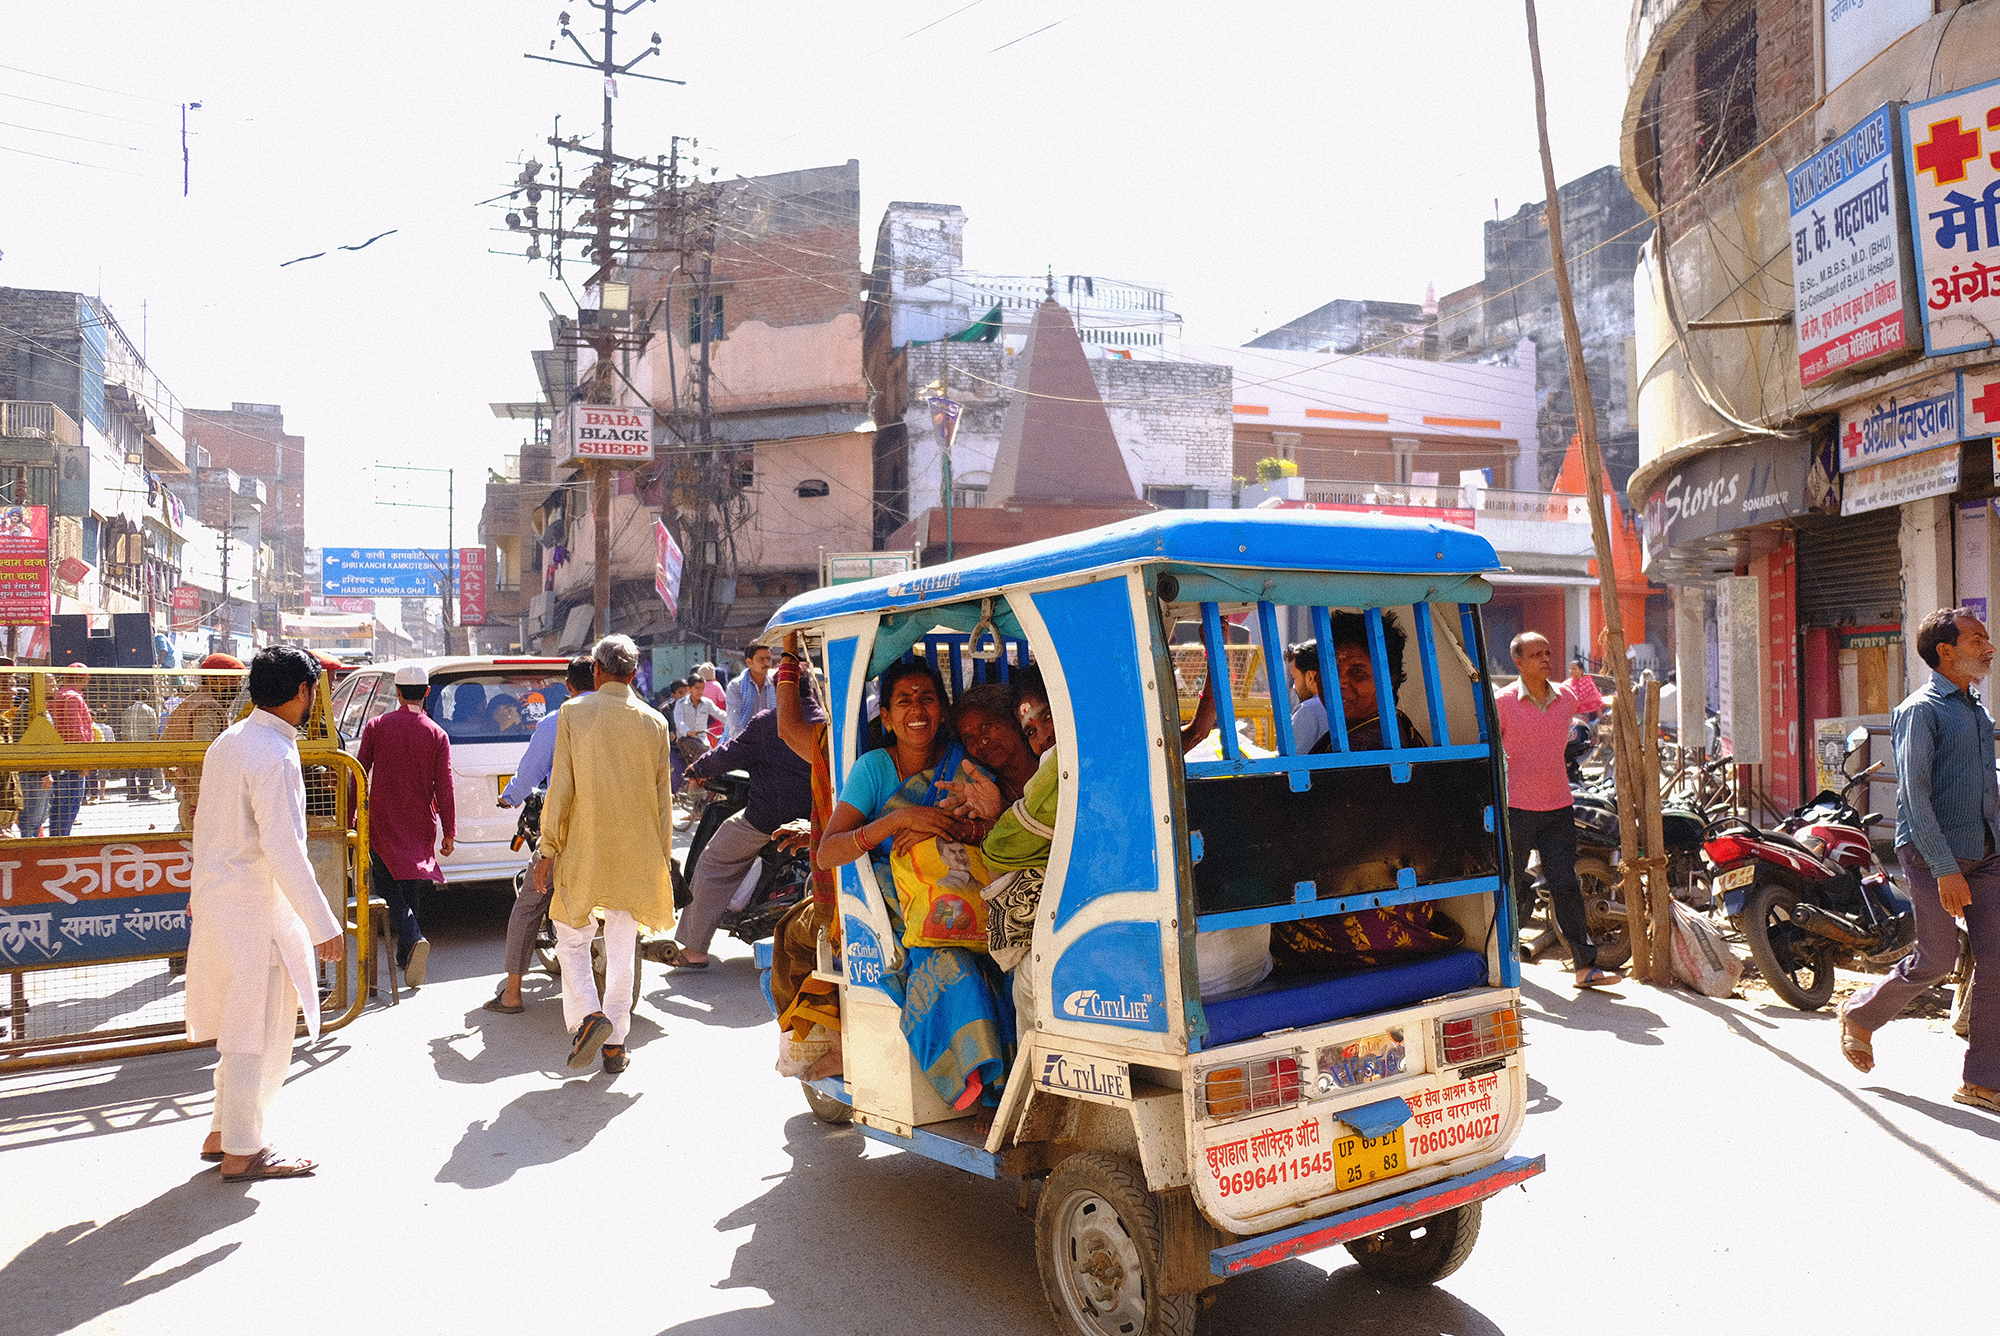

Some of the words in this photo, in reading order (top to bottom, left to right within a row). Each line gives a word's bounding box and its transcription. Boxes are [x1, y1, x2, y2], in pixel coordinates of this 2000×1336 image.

[1793, 163, 1815, 209] SKIN
[1815, 146, 1842, 194] CARE
[1855, 115, 1886, 167] CURE
[1811, 209, 1831, 253] के.
[1868, 234, 1892, 260] (BHU)
[1839, 277, 1847, 291] of
[1867, 252, 1895, 278] Hospital
[1849, 329, 1880, 358] मेडिसिन
[1879, 321, 1901, 347] सेन्टर
[579, 427, 649, 442] BLACK
[586, 412, 643, 427] BABA
[579, 441, 649, 456] SHEEP
[1663, 474, 1739, 537] Stores
[341, 561, 358, 569] SHRI
[351, 550, 360, 560] श्री
[341, 586, 369, 594] HARISH
[369, 587, 405, 595] CHANDRA
[406, 587, 426, 595] GHAT
[380, 576, 396, 585] घाट
[415, 577, 426, 585] 0.3
[463, 571, 481, 612] ARYA
[59, 914, 121, 946] समाज
[1424, 1088, 1441, 1107] सेवा
[1442, 1083, 1467, 1102] आश्रम
[1468, 1077, 1476, 1096] के
[1477, 1071, 1498, 1094] सामने
[1414, 1108, 1443, 1129] पड़ाव
[1447, 1092, 1491, 1120] वाराणसी
[1206, 1139, 1248, 1180] खुशहाल
[1295, 1117, 1320, 1148] ऑटो
[1338, 1140, 1354, 1158] UP
[1382, 1129, 1398, 1146] ET
[1410, 1113, 1500, 1157] 7860304027
[1219, 1151, 1333, 1198] 9696411545
[1347, 1164, 1362, 1183] 25
[1383, 1153, 1398, 1171] 83
